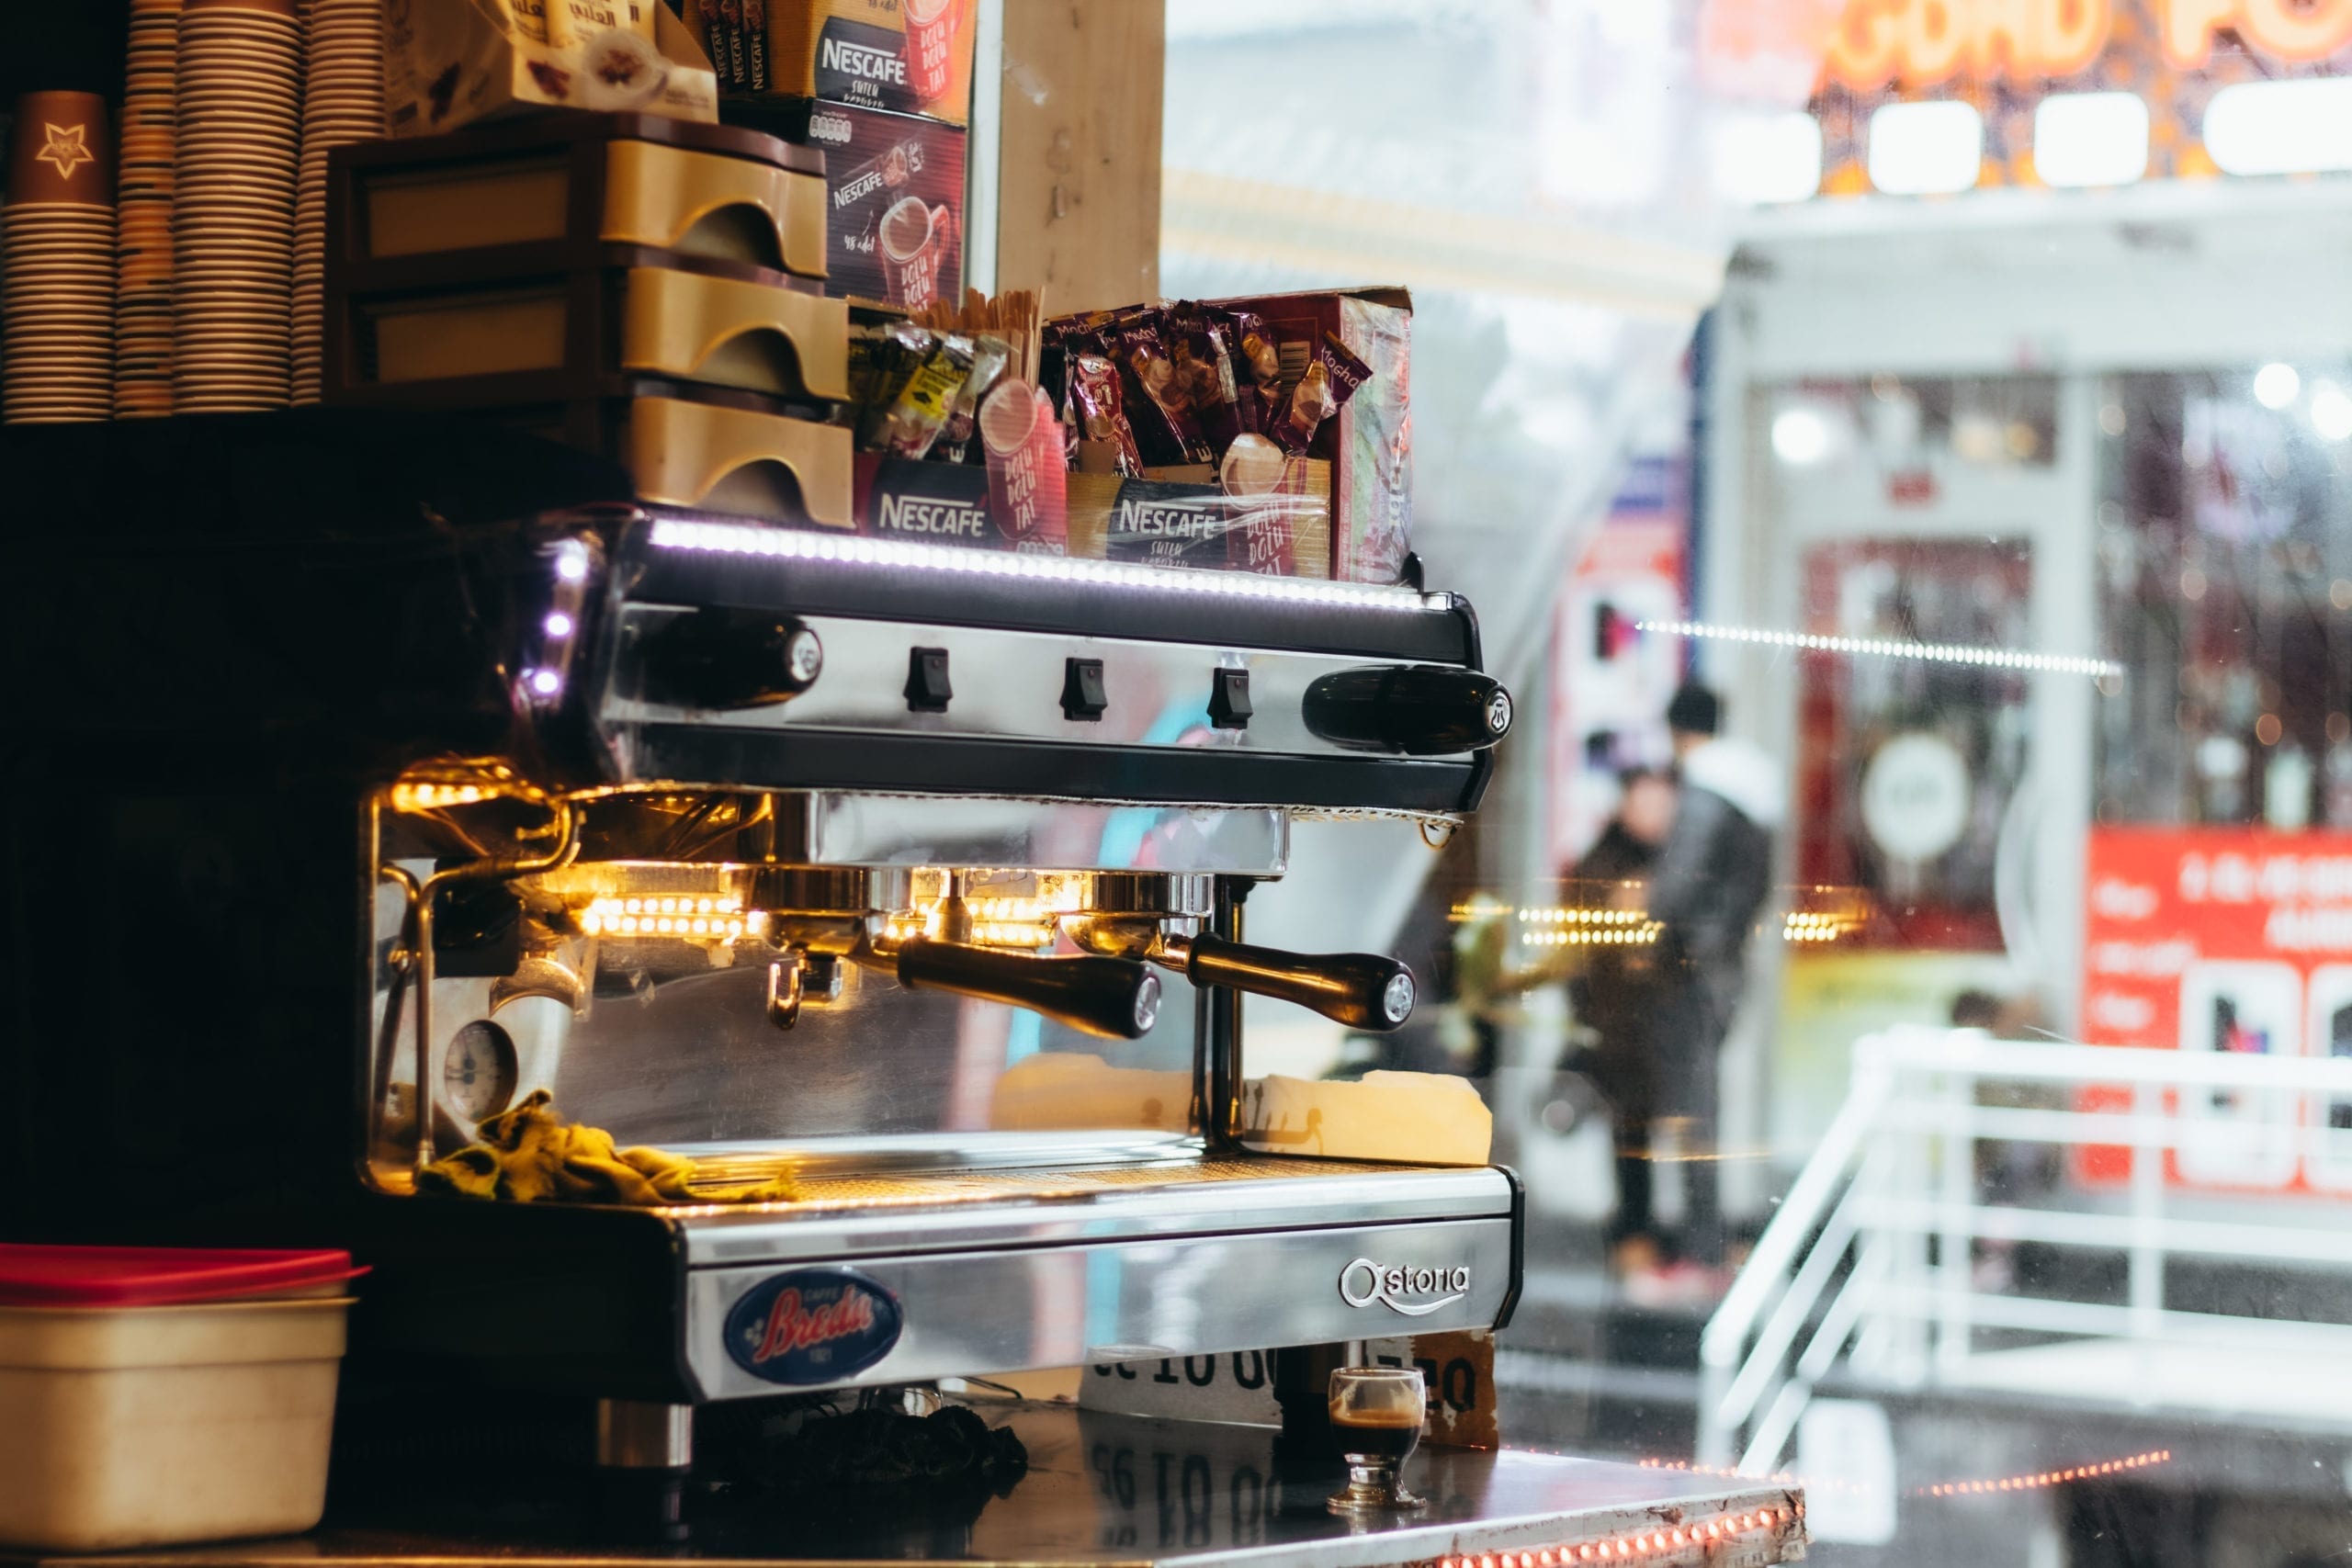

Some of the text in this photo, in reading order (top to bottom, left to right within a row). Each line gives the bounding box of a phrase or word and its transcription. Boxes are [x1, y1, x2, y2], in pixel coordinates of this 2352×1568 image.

[928, 64, 945, 93] TAT
[1321, 344, 1360, 389] Mocha
[1007, 470, 1036, 506] DOLU
[1014, 497, 1035, 530] TAT
[1250, 526, 1283, 566] DOLU
[1339, 1258, 1470, 1315] Astoria
